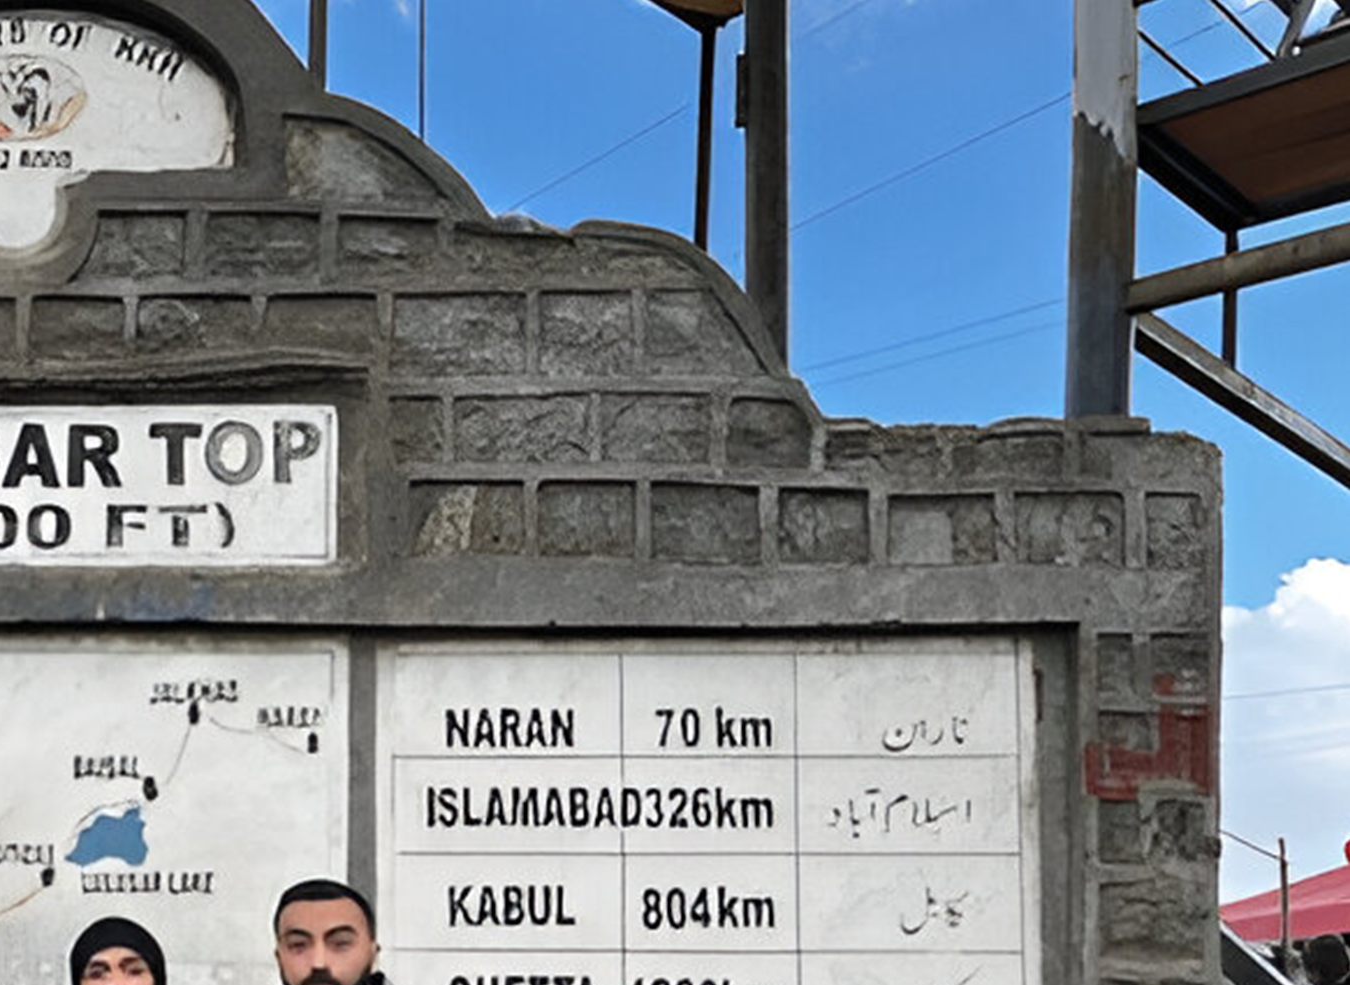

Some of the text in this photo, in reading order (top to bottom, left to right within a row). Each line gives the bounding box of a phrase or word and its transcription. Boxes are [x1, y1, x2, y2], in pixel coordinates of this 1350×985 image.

[148, 420, 321, 487] TOP
[105, 501, 236, 550] FT)
[445, 706, 773, 749] NARAN 70 km
[426, 786, 641, 829] ISLAMABAD
[448, 884, 576, 928] KABUL
